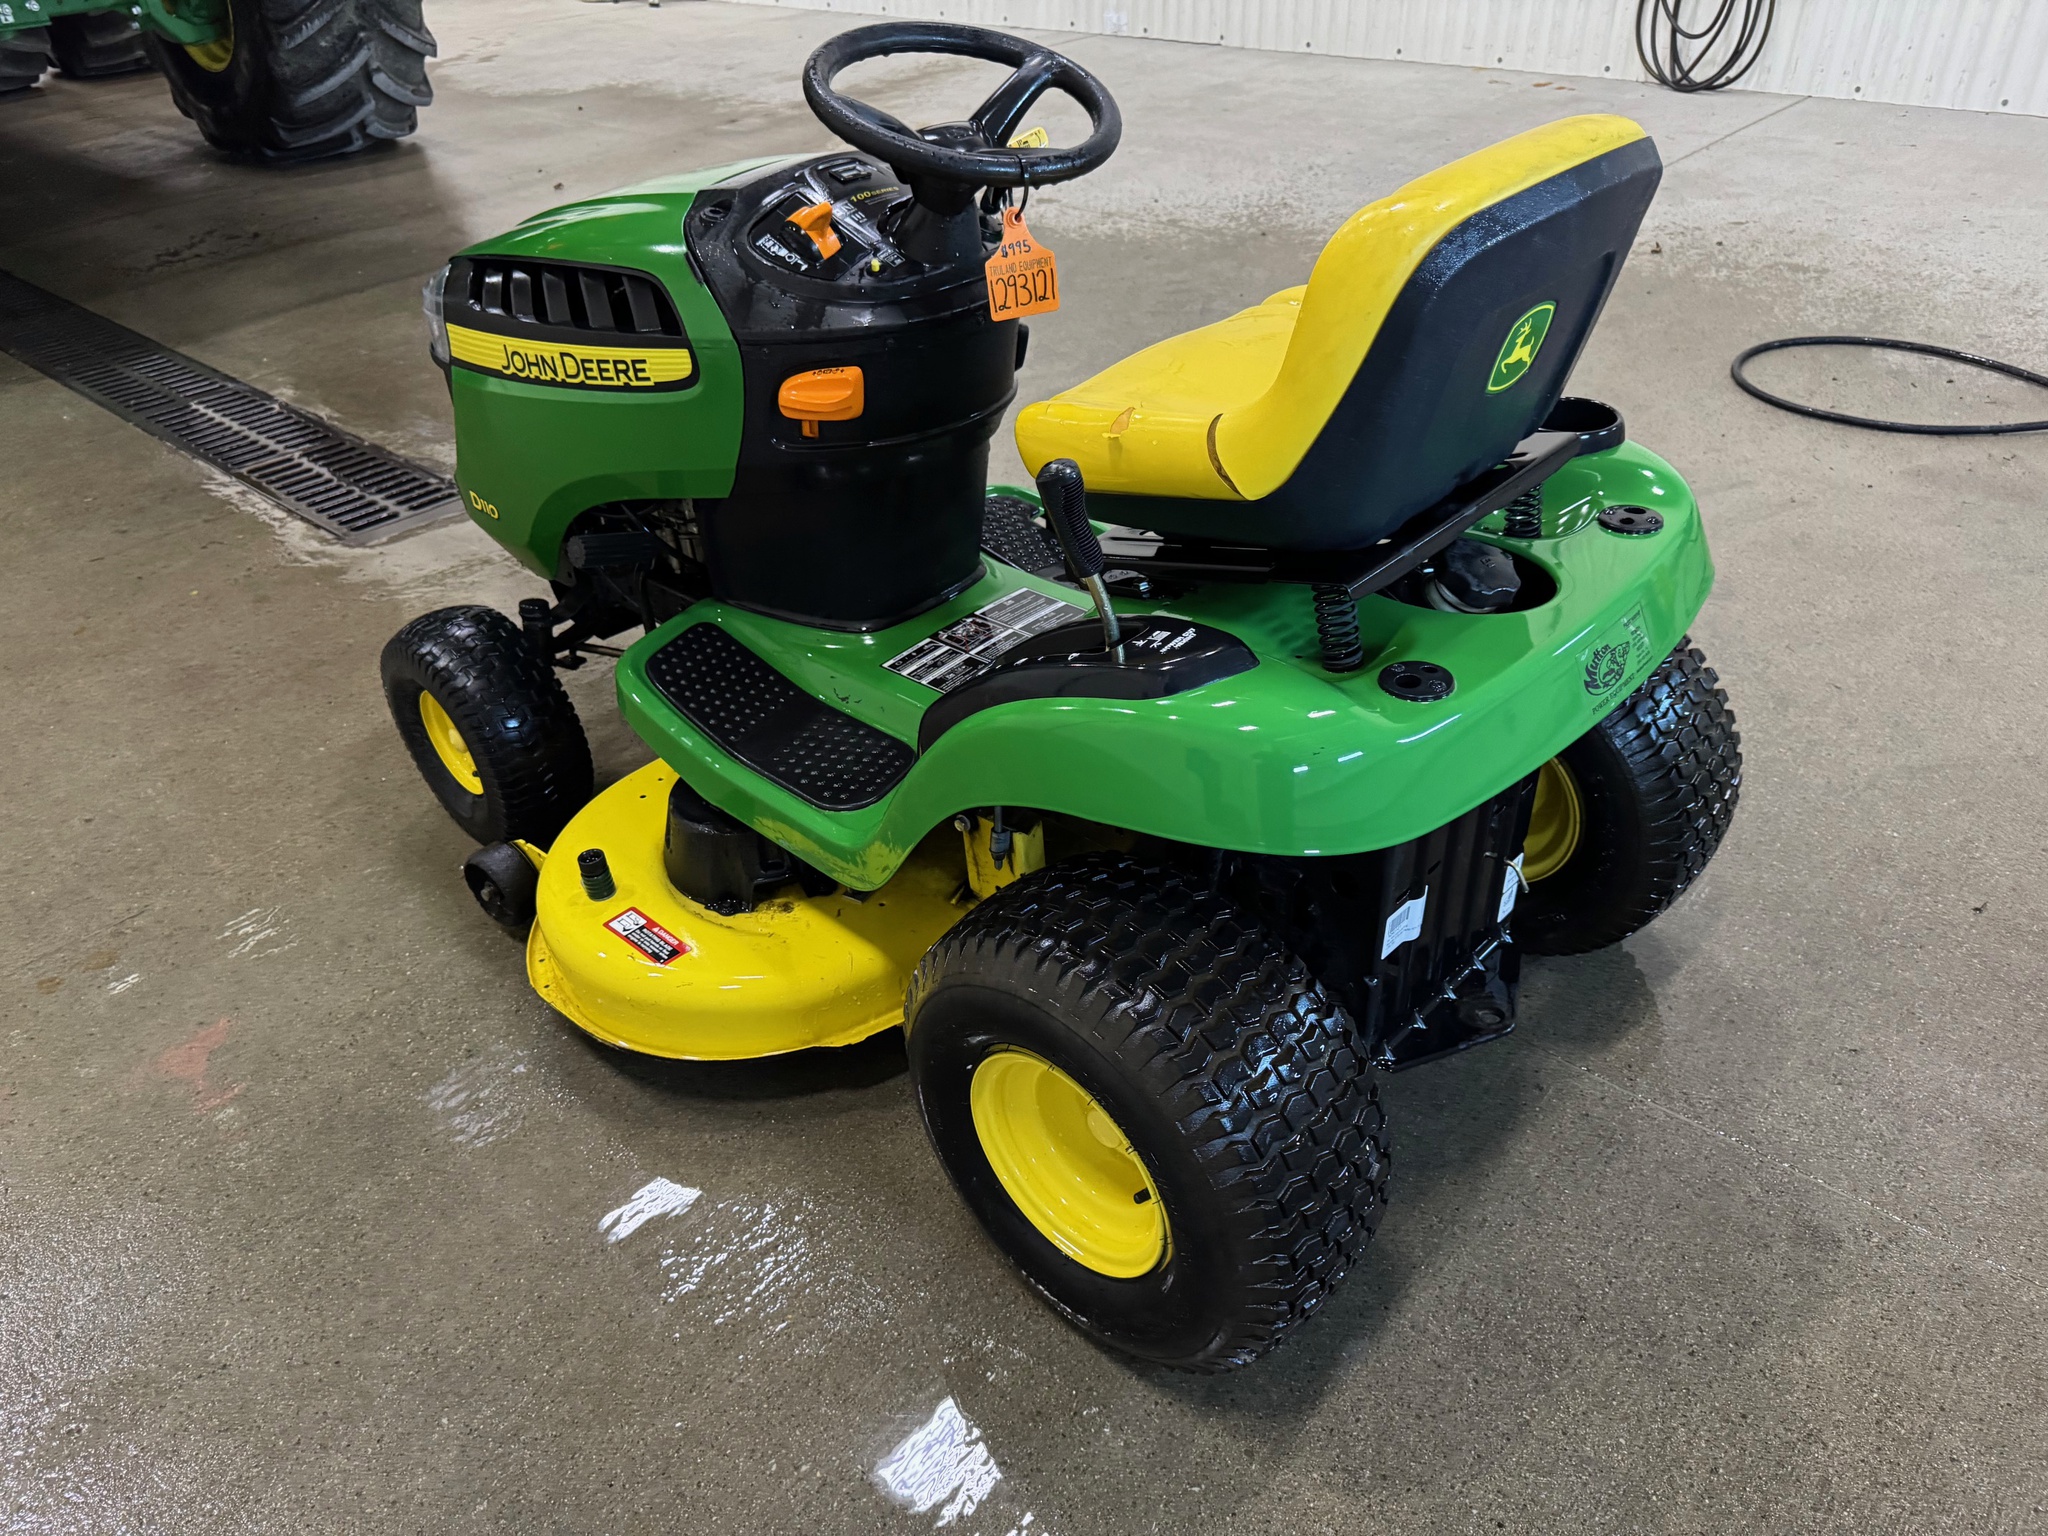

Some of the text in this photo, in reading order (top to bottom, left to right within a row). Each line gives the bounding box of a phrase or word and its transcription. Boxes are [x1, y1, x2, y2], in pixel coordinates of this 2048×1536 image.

[850, 191, 872, 202] 100
[1018, 256, 1052, 272] EQUIPMENT
[990, 267, 1056, 313] 1293121
[501, 343, 652, 382] JOHN DEERE
[469, 490, 499, 519] D110
[656, 929, 680, 945] DANGER
